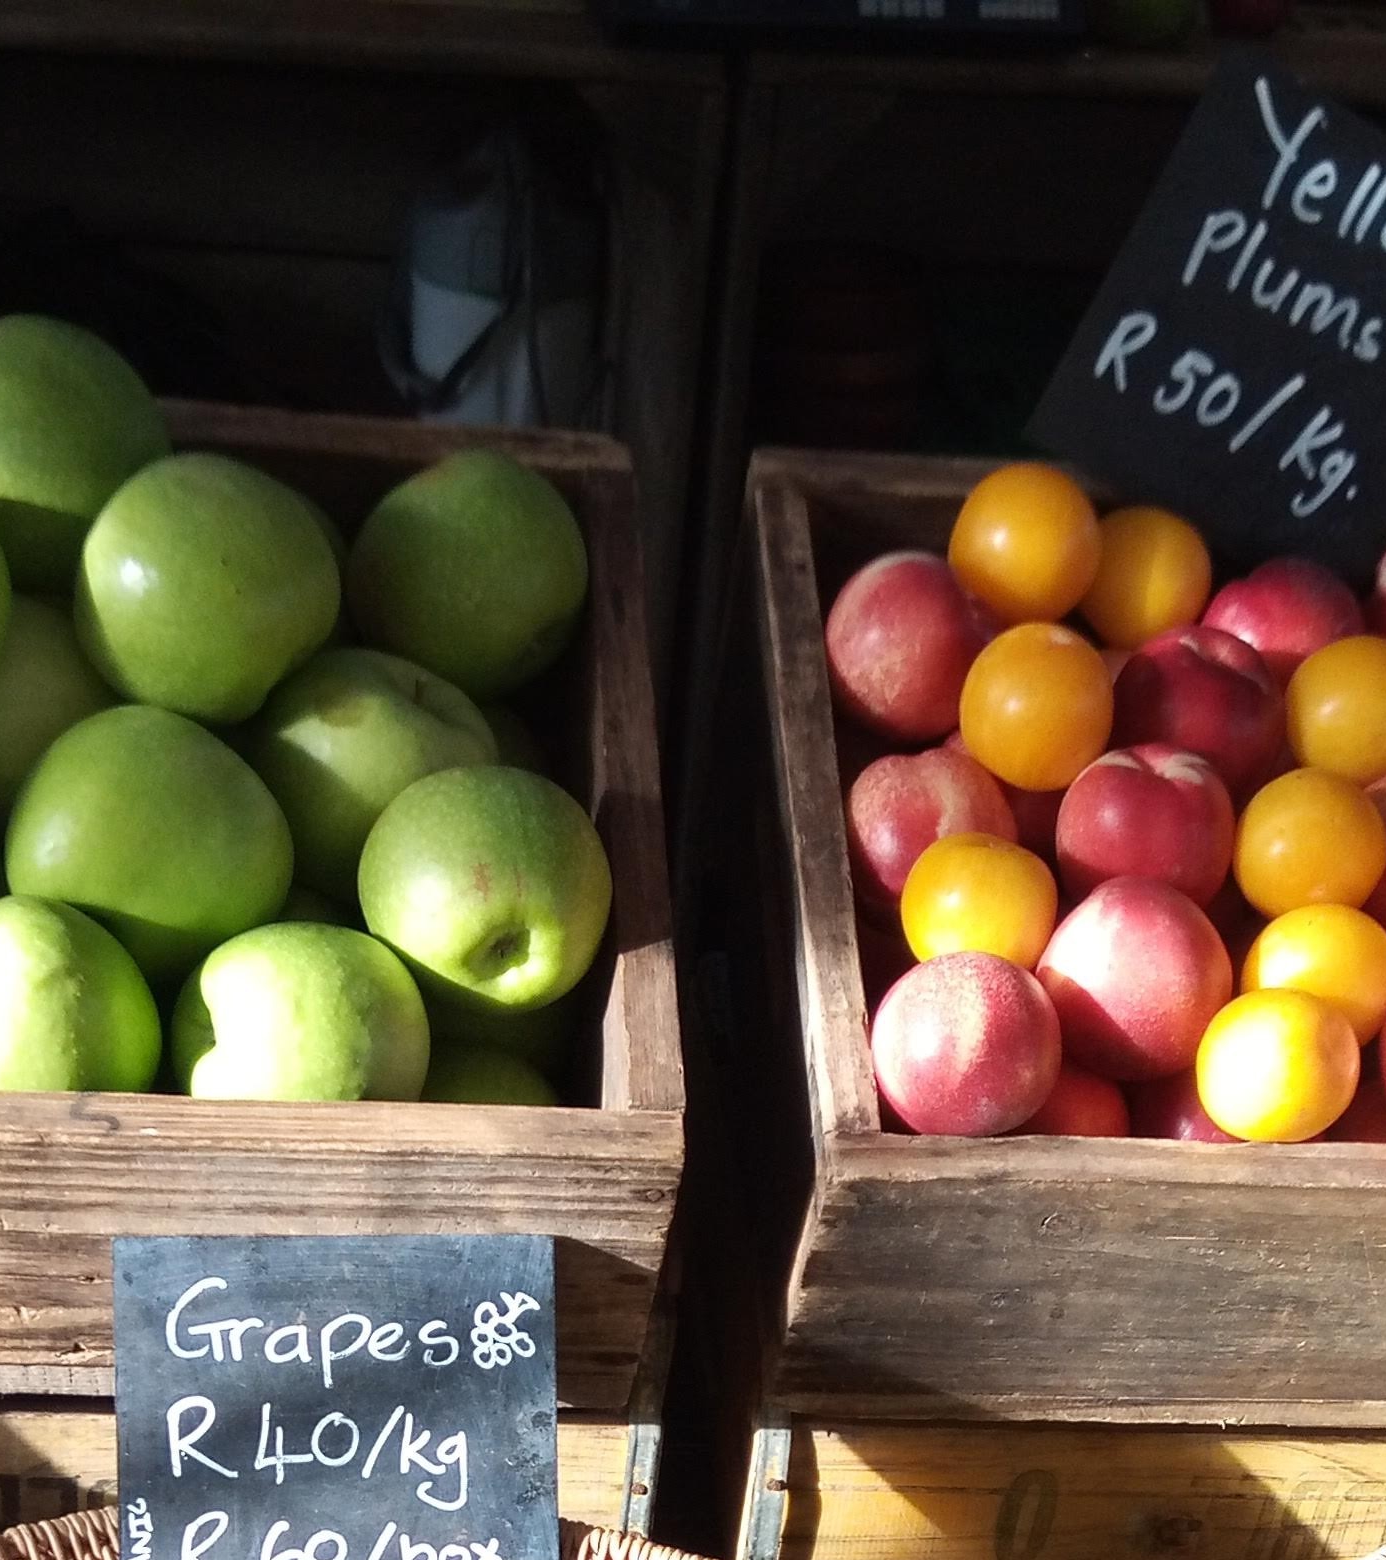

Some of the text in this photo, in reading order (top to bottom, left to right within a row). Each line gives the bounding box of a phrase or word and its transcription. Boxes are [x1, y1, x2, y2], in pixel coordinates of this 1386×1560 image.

[1181, 209, 1384, 363] Plums
[1093, 310, 1158, 394] R
[165, 1276, 459, 1389] Grapes
